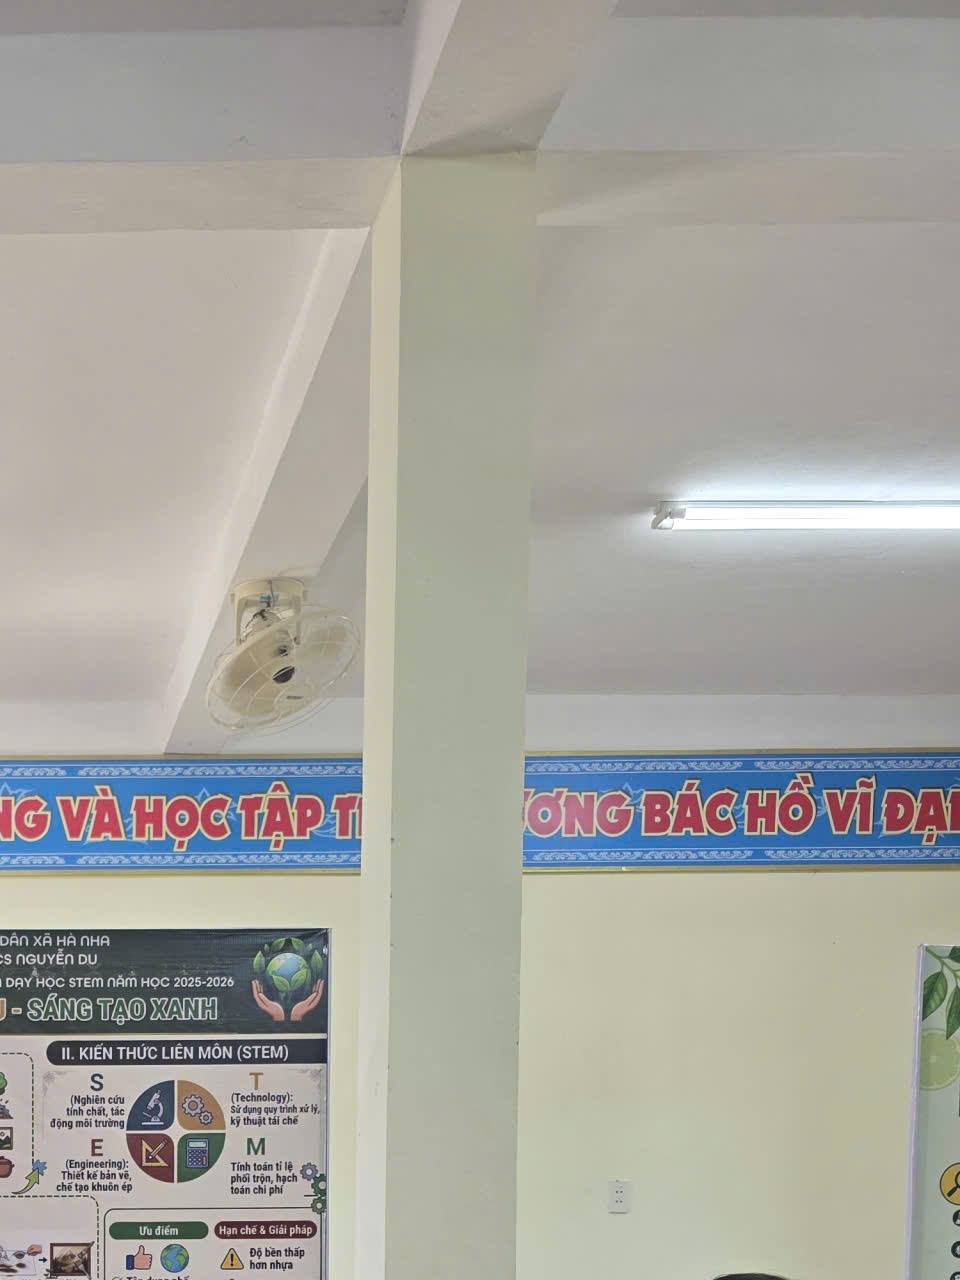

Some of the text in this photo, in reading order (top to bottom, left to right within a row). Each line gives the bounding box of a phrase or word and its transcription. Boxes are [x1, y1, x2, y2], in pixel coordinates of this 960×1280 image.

[641, 779, 739, 837] BÁC
[744, 773, 816, 836] HỒ
[823, 775, 877, 834] VĨ
[56, 785, 125, 841] VÀ
[131, 793, 233, 852] HỌC
[237, 780, 326, 851] TẬP
[0, 933, 29, 947] DÂN
[32, 932, 53, 946] XÃ
[57, 932, 78, 946] HÀ
[80, 935, 110, 946] NHA
[16, 948, 74, 965] NGUYỄN
[78, 954, 97, 965] DU
[36, 976, 65, 989] HỌC
[69, 976, 104, 987] STEM
[107, 974, 137, 987] NĂM
[141, 976, 170, 989] HỌC
[174, 977, 234, 987] 2025-2026
[27, 993, 93, 1021] SÁNG
[97, 997, 146, 1025] TẠO
[151, 997, 218, 1020] XANH
[61, 1043, 289, 1062] II. KIẾN THỨC LIÊN MÔN (STEM)
[90, 1073, 104, 1092] S
[249, 1072, 264, 1090] T
[231, 1092, 293, 1104] (Technology):
[91, 1139, 103, 1156] E
[246, 1137, 265, 1155] M
[65, 1159, 129, 1171] (Engineering):
[139, 1225, 178, 1236] Ưu điểm
[219, 1224, 312, 1237] Hạn chế & Giải pháp
